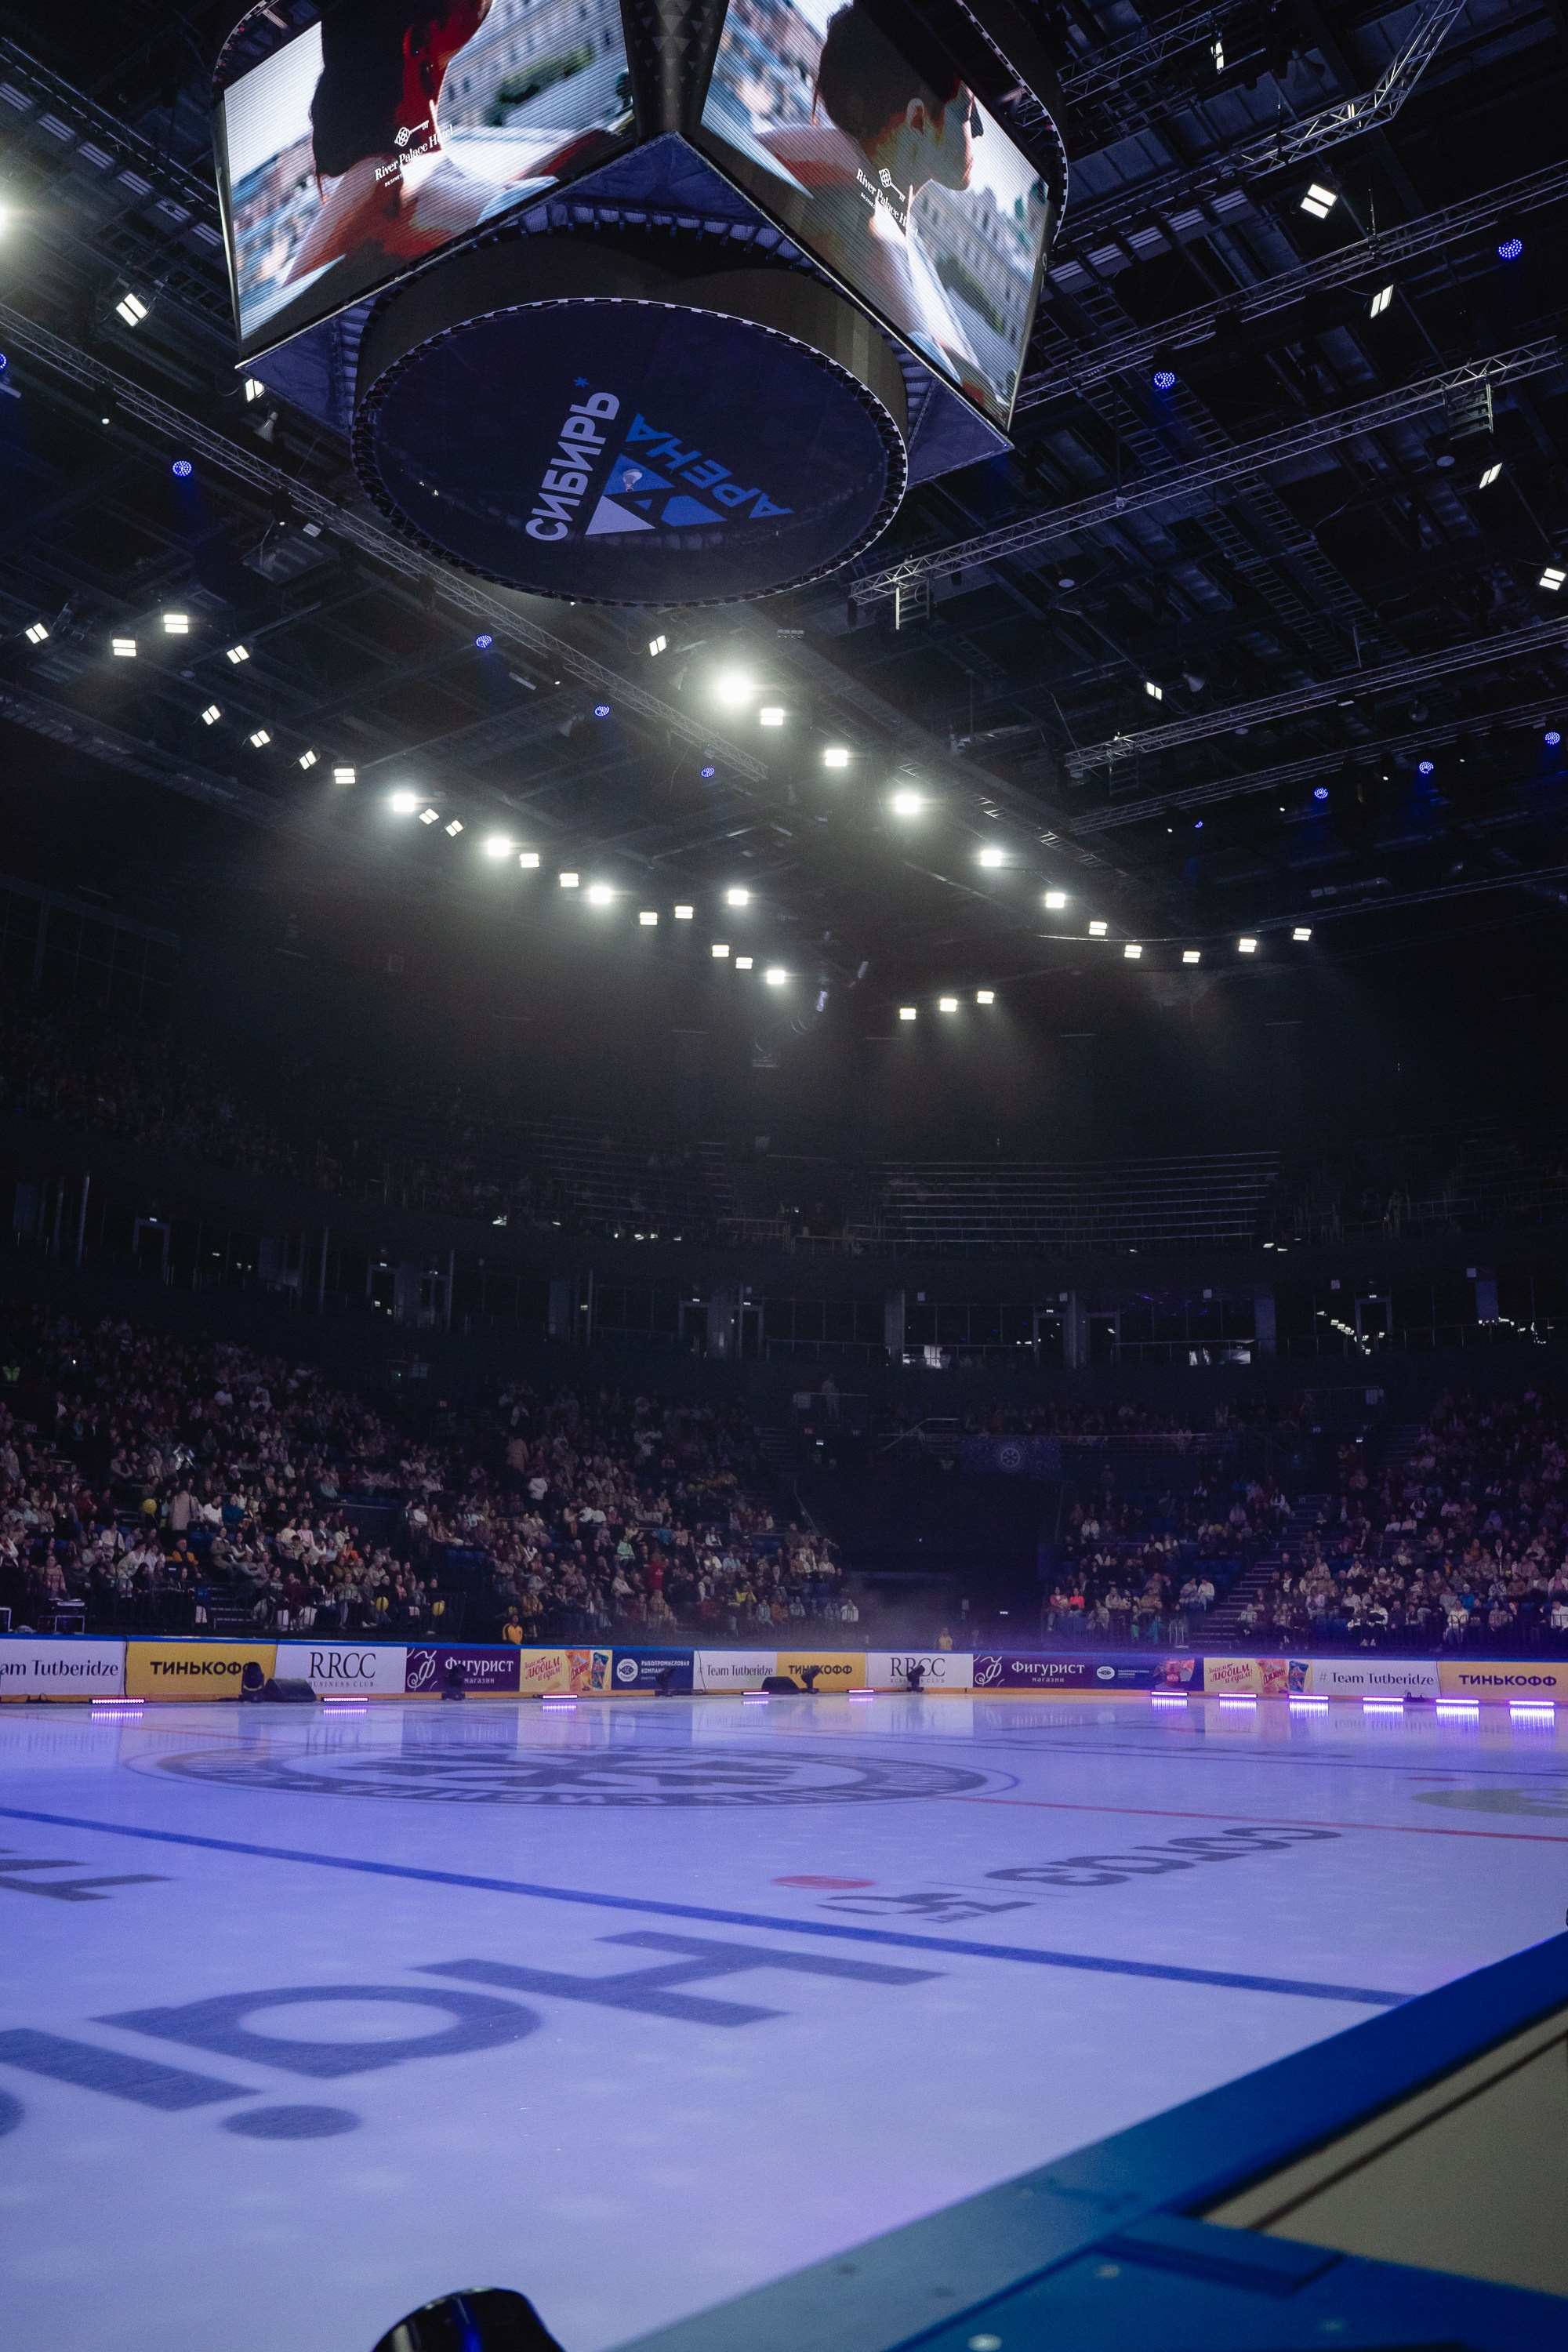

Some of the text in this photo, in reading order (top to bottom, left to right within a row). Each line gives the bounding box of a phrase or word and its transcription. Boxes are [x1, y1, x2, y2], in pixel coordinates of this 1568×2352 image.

[374, 159, 398, 181] River
[398, 143, 428, 166] Palace
[856, 168, 877, 195] River
[525, 392, 620, 541] СИБИРЬ
[625, 412, 796, 519] АРЕНА
[31, 1659, 118, 1676] Tutberidze
[308, 1651, 376, 1679] RRCC
[706, 1664, 729, 1676] Team
[731, 1664, 773, 1676] Tutberidze
[788, 1664, 852, 1675] ТИНКОФФ
[1011, 1661, 1085, 1676] Фигурист
[1333, 1671, 1365, 1684] Team
[1368, 1671, 1435, 1686] Tutberidze
[1458, 1675, 1557, 1686] ТИНЬКОФФ
